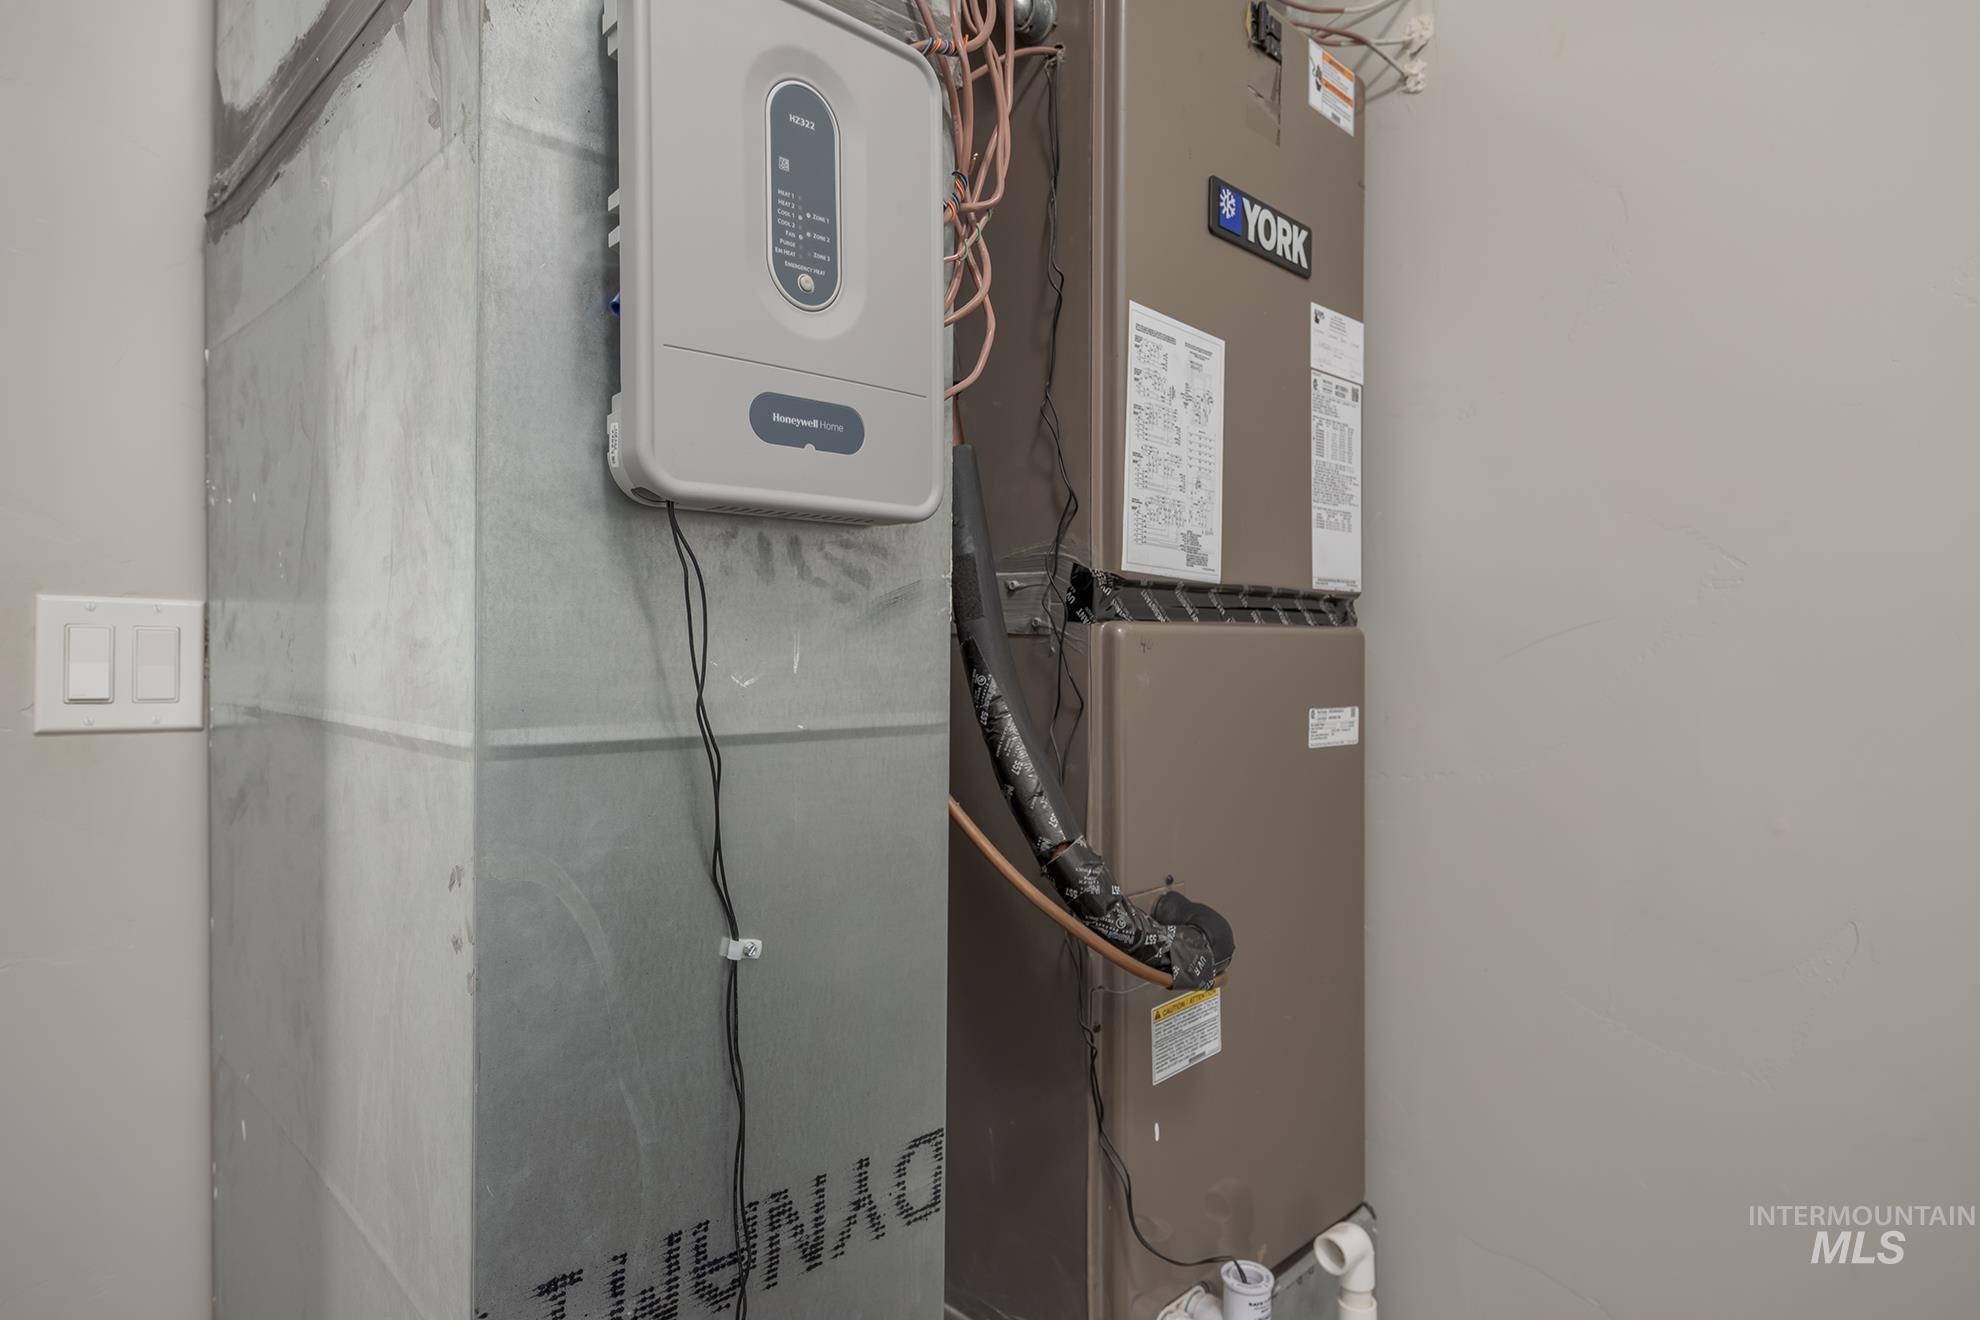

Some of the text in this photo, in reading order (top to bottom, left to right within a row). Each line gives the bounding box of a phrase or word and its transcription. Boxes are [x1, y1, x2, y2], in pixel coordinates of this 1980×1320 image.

[789, 113, 815, 131] HZ322
[1242, 196, 1308, 270] YORK
[784, 260, 813, 273] EMERGENCY
[772, 412, 844, 432] Honeywell Home
